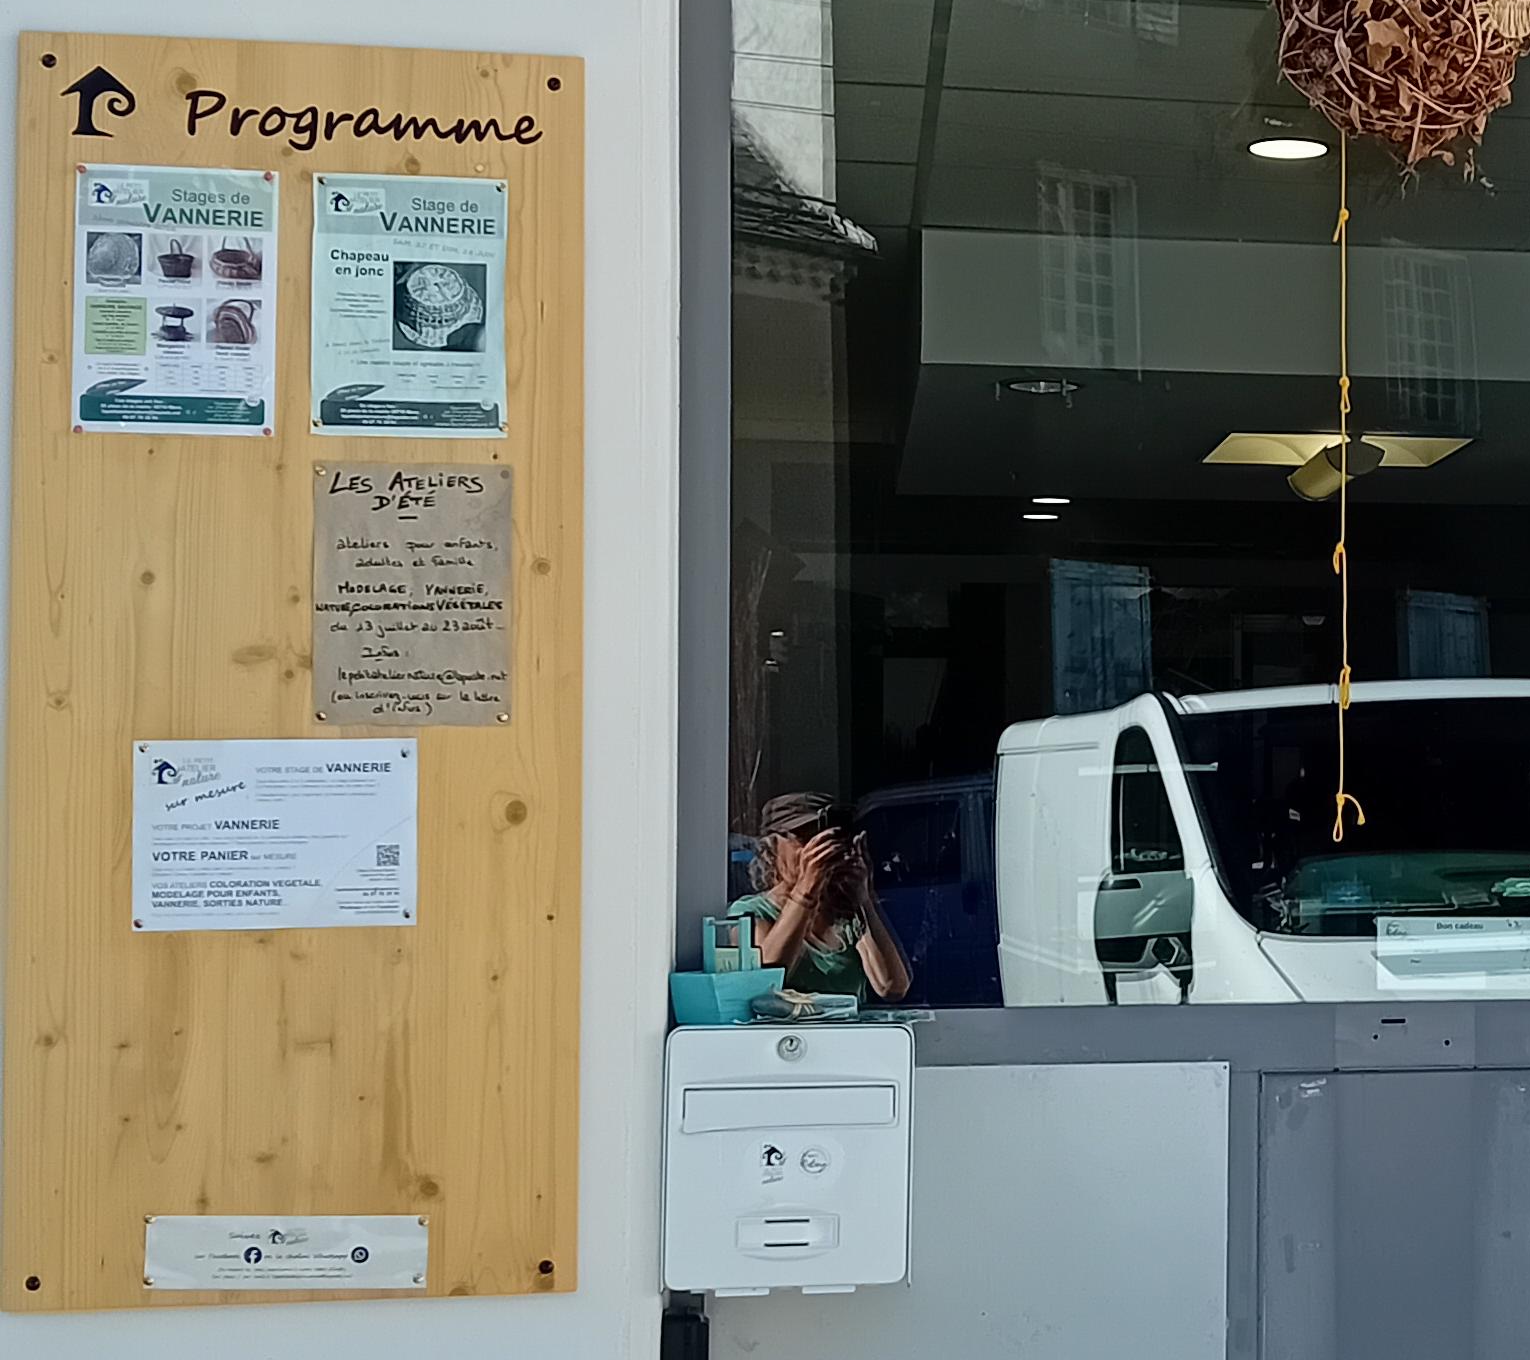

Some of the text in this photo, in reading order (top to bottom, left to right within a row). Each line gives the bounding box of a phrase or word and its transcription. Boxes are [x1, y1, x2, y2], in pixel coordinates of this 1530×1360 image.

[185, 89, 544, 151] Programme
[172, 188, 250, 206] Stages de
[411, 197, 478, 214] Stage de
[143, 202, 264, 227] VANNERIE
[380, 212, 496, 235] VANNERIE
[330, 249, 389, 264] Chapeau
[335, 266, 384, 278] en jonc
[329, 471, 373, 494] LES
[336, 537, 390, 550] ateliers
[412, 557, 425, 567] et
[442, 620, 459, 632] 23
[326, 762, 392, 773] VANNERIE
[194, 782, 246, 802] mesure
[214, 819, 280, 831] VANNERIE
[152, 851, 196, 862] VOTRE
[200, 850, 248, 861] PANIER
[209, 880, 270, 888] COLORATION
[207, 890, 233, 898] POUR
